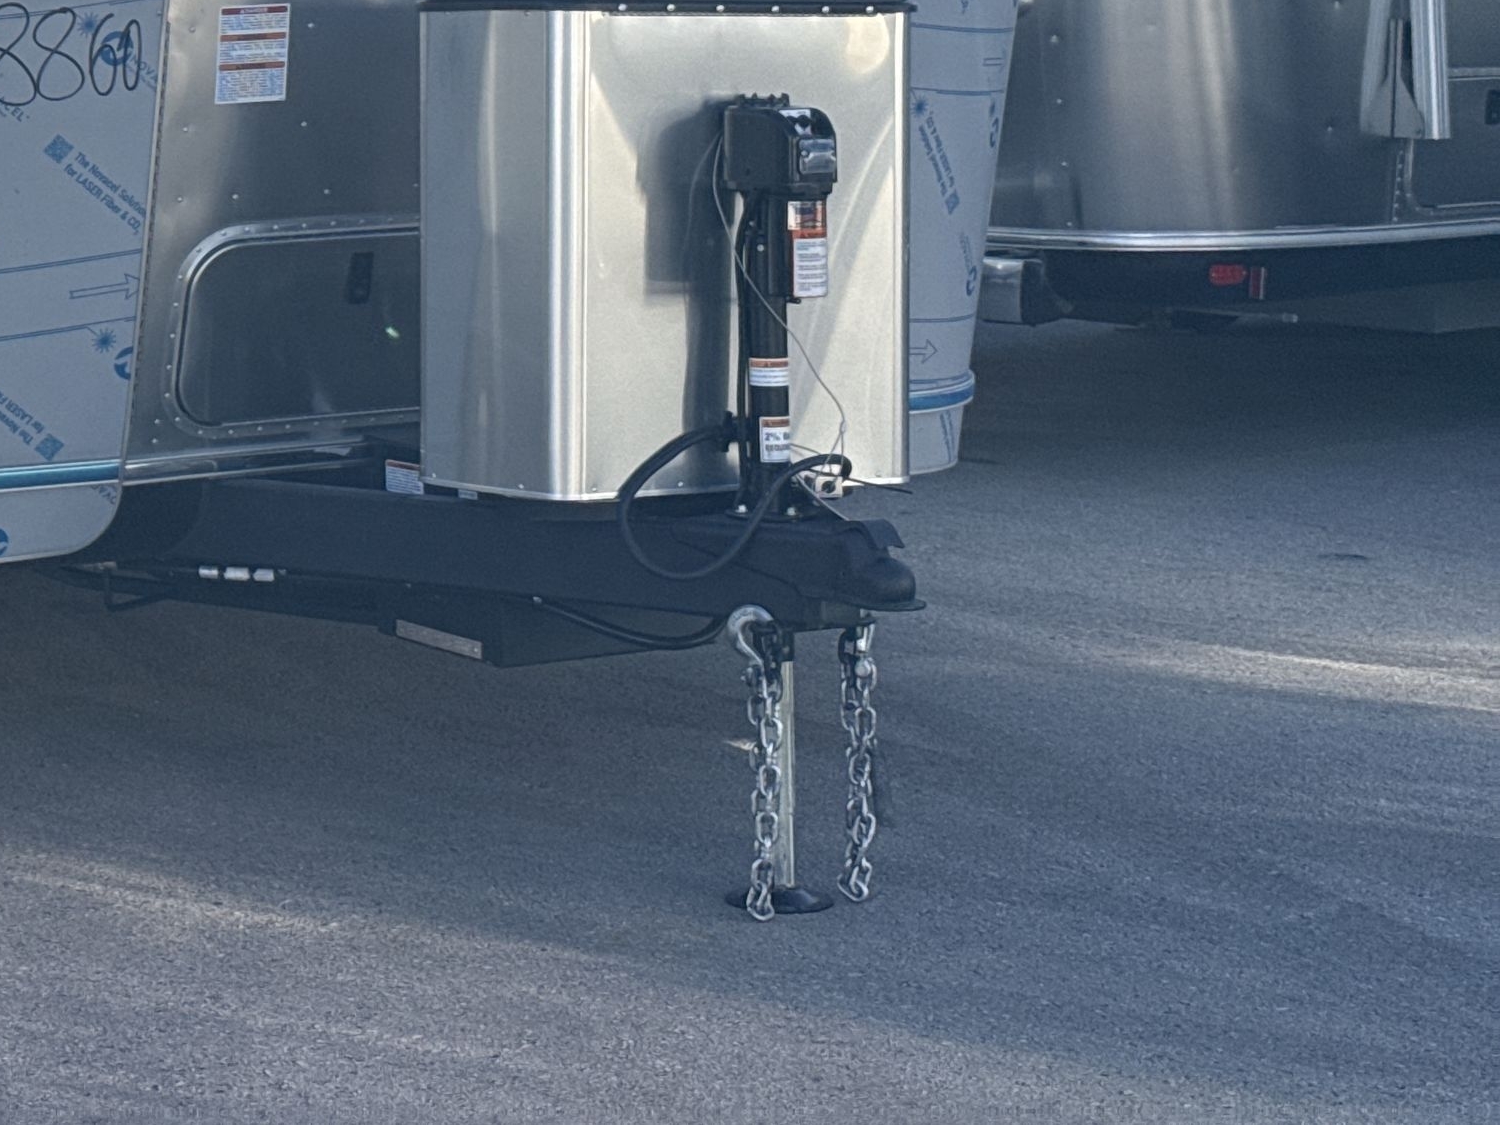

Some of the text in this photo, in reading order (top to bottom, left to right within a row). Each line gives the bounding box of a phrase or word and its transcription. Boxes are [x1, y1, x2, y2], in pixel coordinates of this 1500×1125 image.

[74, 151, 90, 169] The
[88, 163, 121, 193] Novacel
[63, 163, 78, 178] for
[75, 173, 104, 200] LASER
[100, 193, 122, 214] Fiber
[5, 398, 34, 426] LASER
[18, 429, 34, 446] The
[31, 419, 46, 435] for
